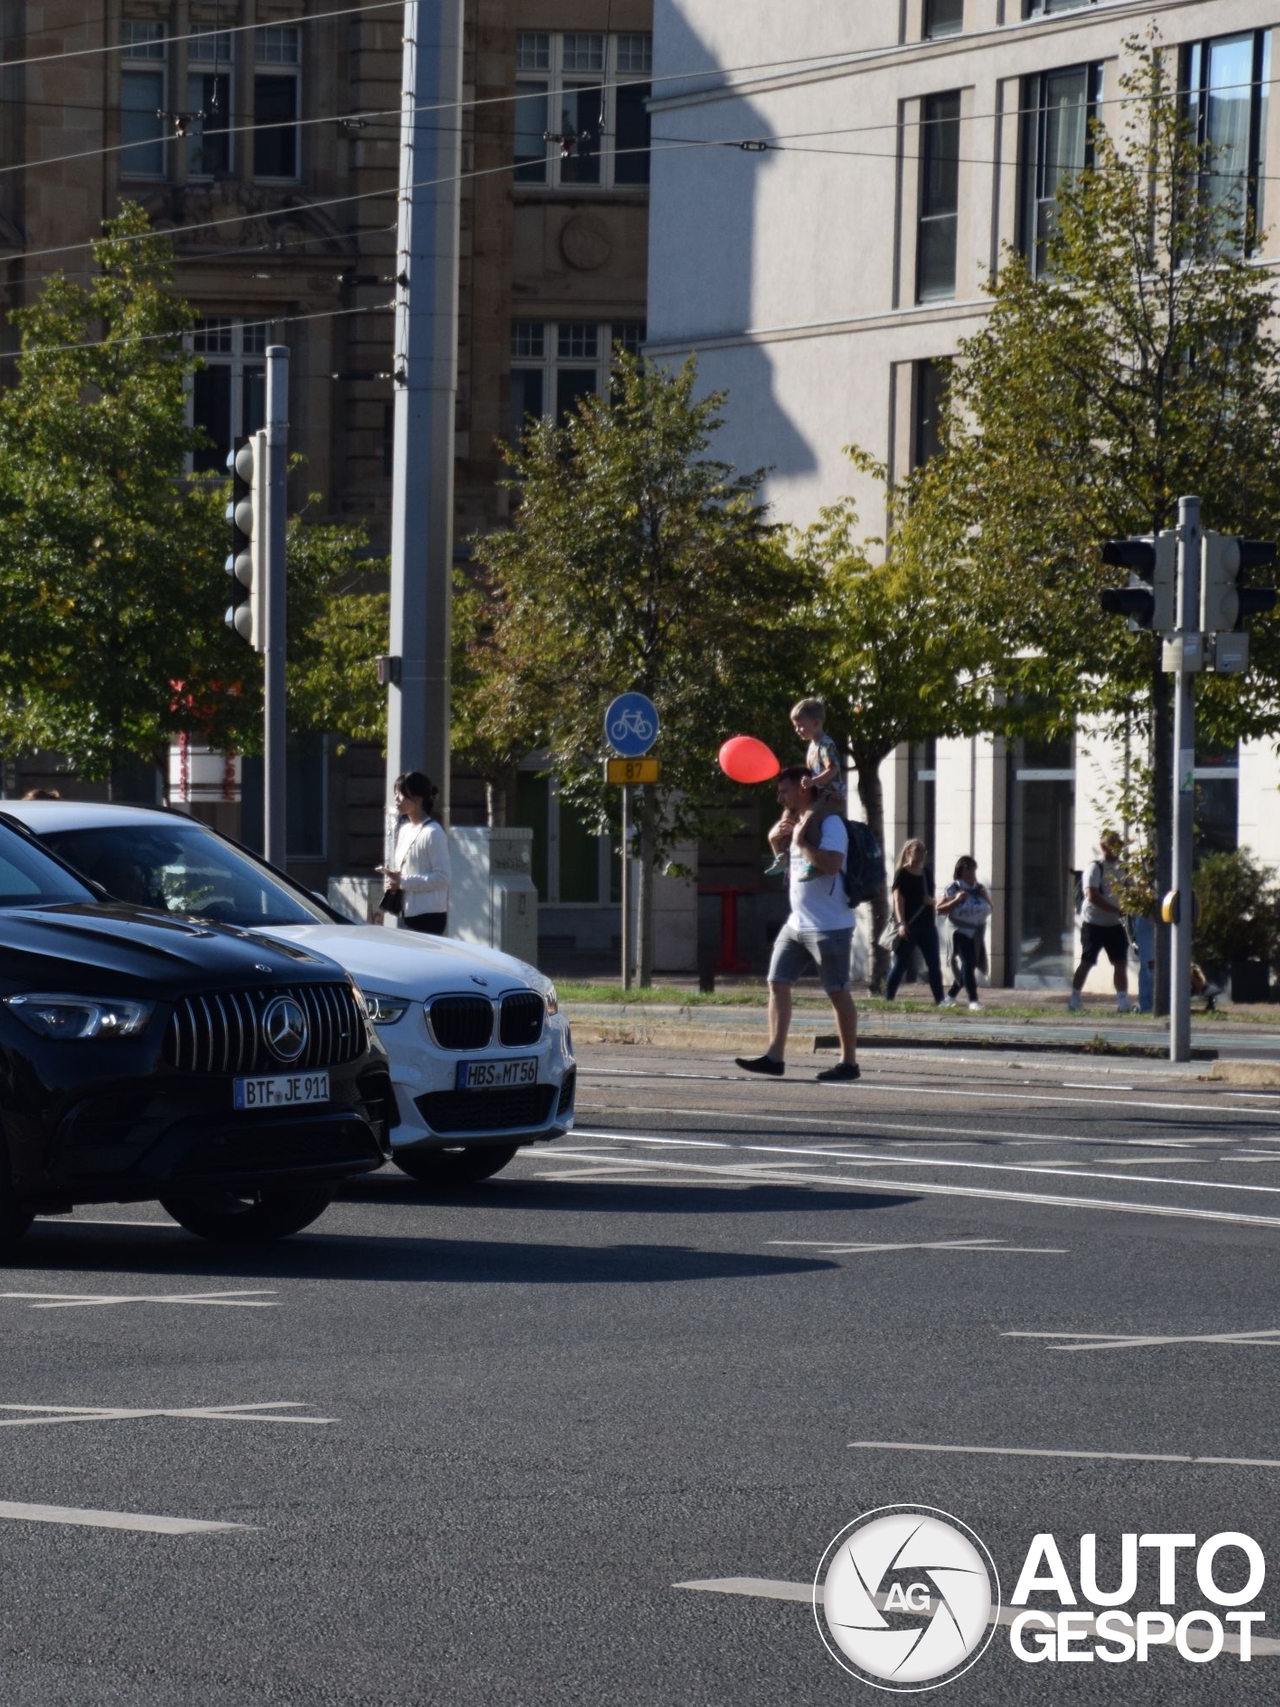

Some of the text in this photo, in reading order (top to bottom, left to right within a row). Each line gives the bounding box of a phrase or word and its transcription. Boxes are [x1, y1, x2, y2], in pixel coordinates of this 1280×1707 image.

[626, 763, 642, 779] 87
[467, 1061, 535, 1086] HBS MT 56
[246, 1076, 329, 1105] BTF JE 911
